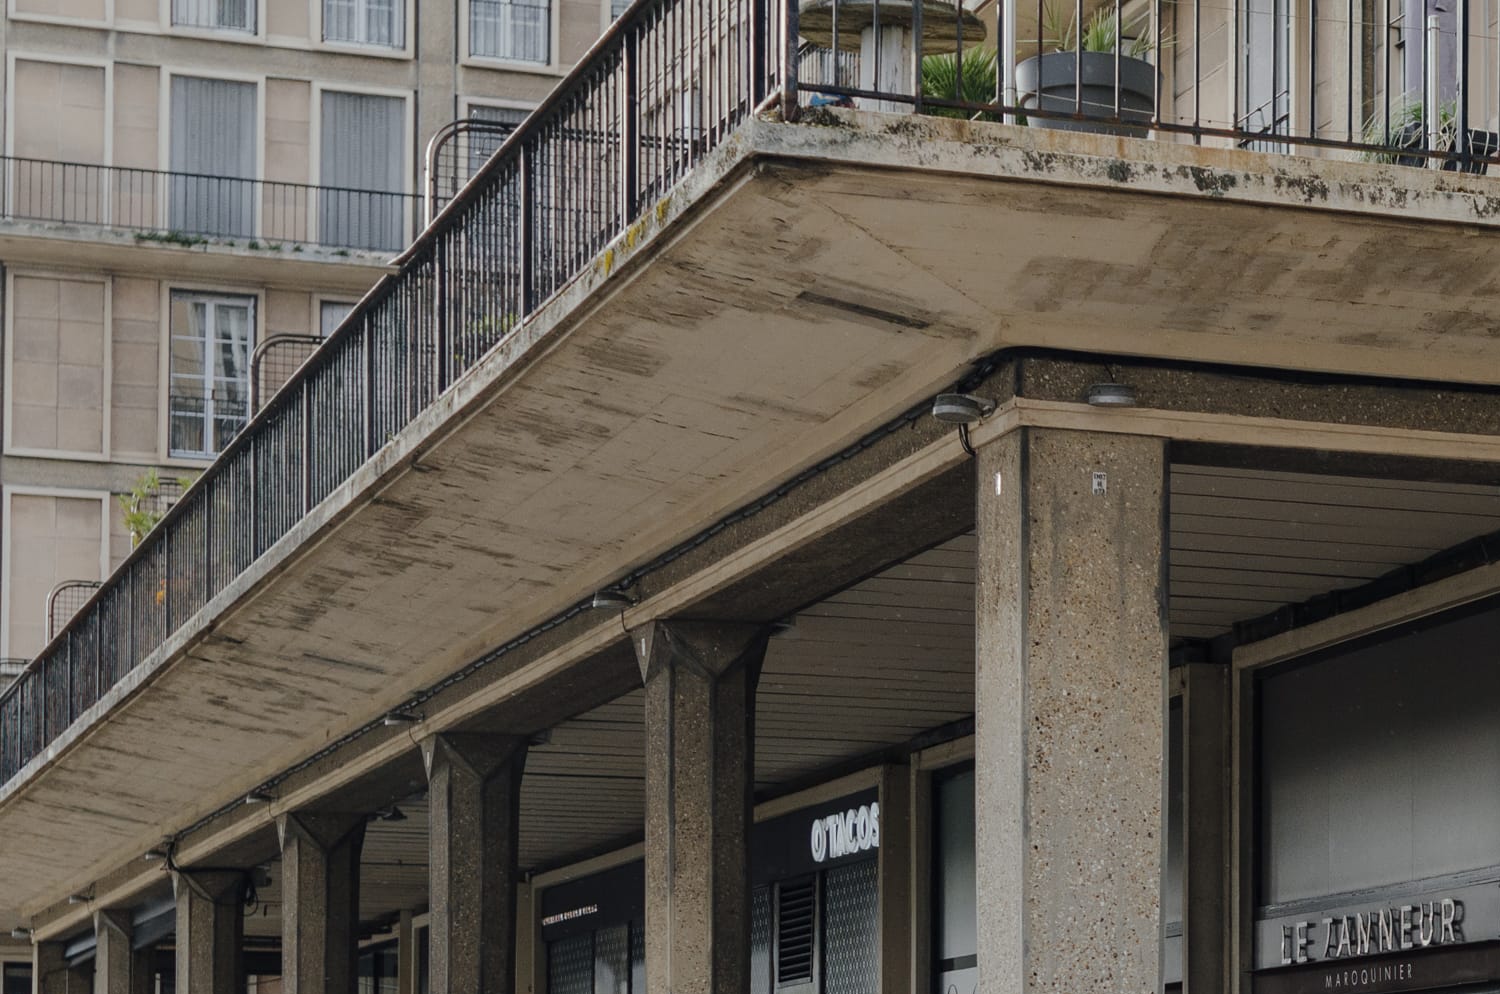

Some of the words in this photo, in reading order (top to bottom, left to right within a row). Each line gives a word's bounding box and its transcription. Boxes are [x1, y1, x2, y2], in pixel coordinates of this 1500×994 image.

[811, 801, 879, 862] O'TACOS
[1281, 920, 1308, 965] LE
[1322, 898, 1457, 958] TANNEUR
[1325, 963, 1413, 988] MAROQUINIER
